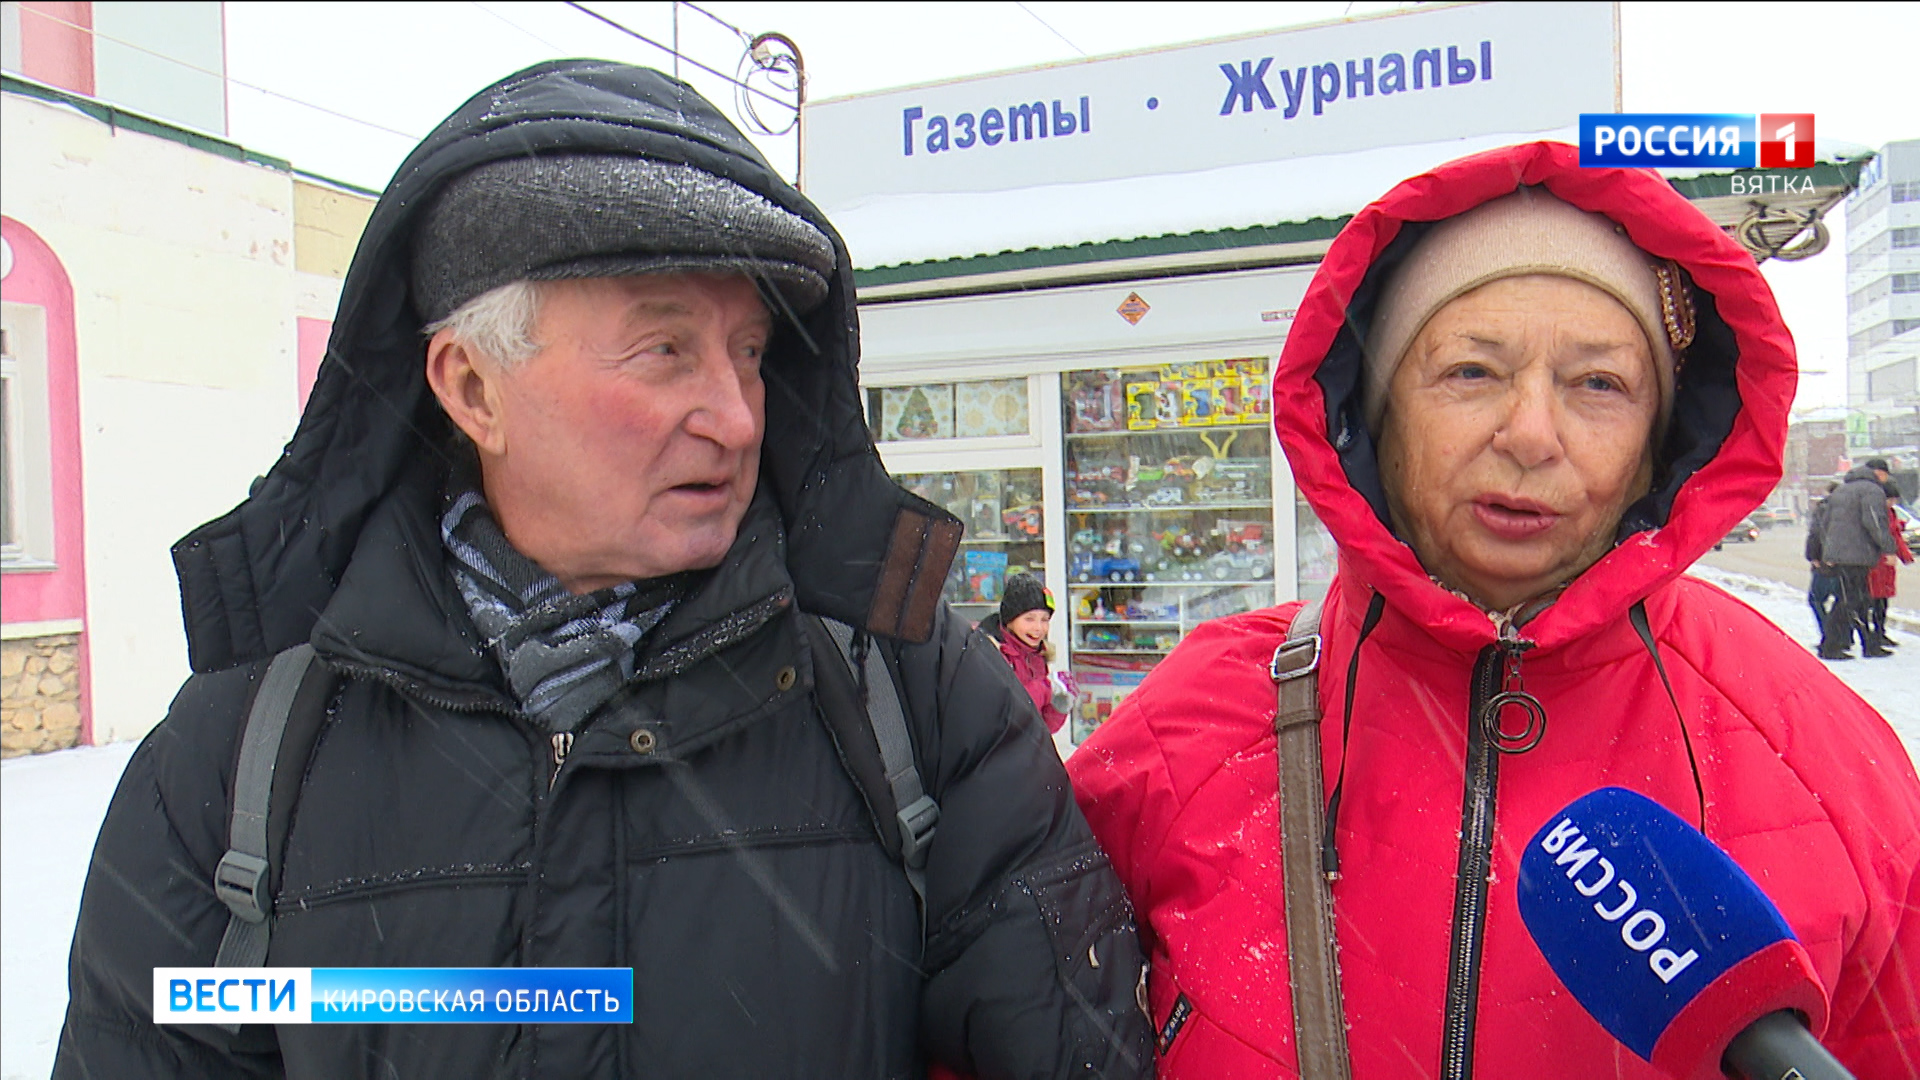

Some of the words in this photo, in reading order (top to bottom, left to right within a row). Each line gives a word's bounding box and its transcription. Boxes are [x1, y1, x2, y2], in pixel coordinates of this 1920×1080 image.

[902, 95, 1090, 157] Газеты
[1218, 40, 1493, 120] Журналы
[1541, 818, 1699, 984] РОССИЯ
